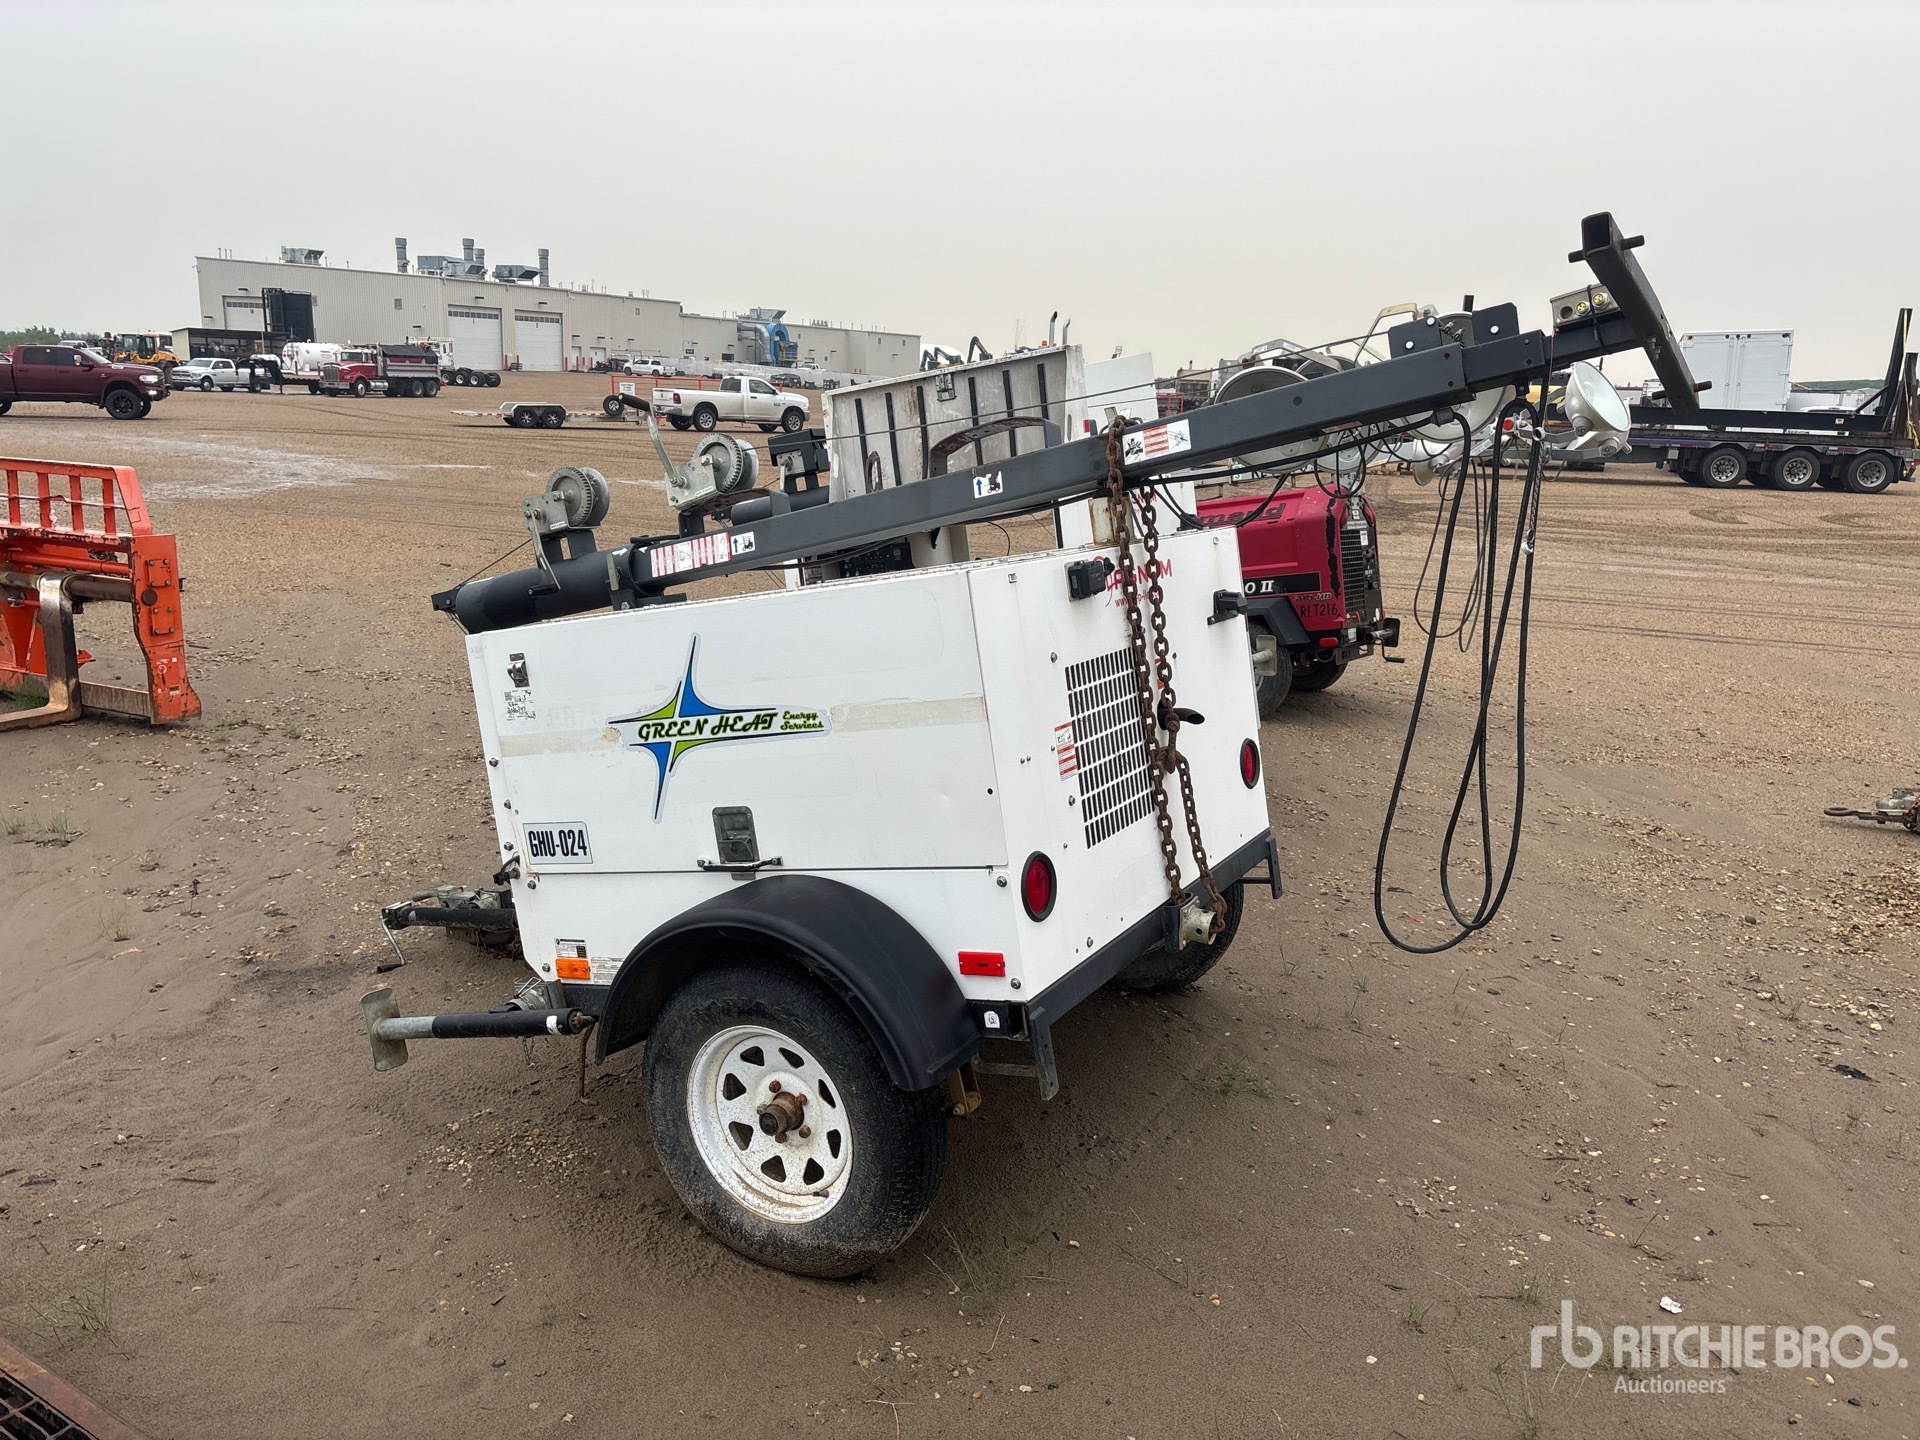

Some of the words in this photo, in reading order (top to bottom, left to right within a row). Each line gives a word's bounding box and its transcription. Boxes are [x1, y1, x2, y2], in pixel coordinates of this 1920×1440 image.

[780, 719, 824, 731] Services
[782, 710, 819, 722] Energy
[638, 718, 709, 742] GREEN
[710, 712, 778, 736] HEAT
[528, 829, 588, 857] GHU-024
